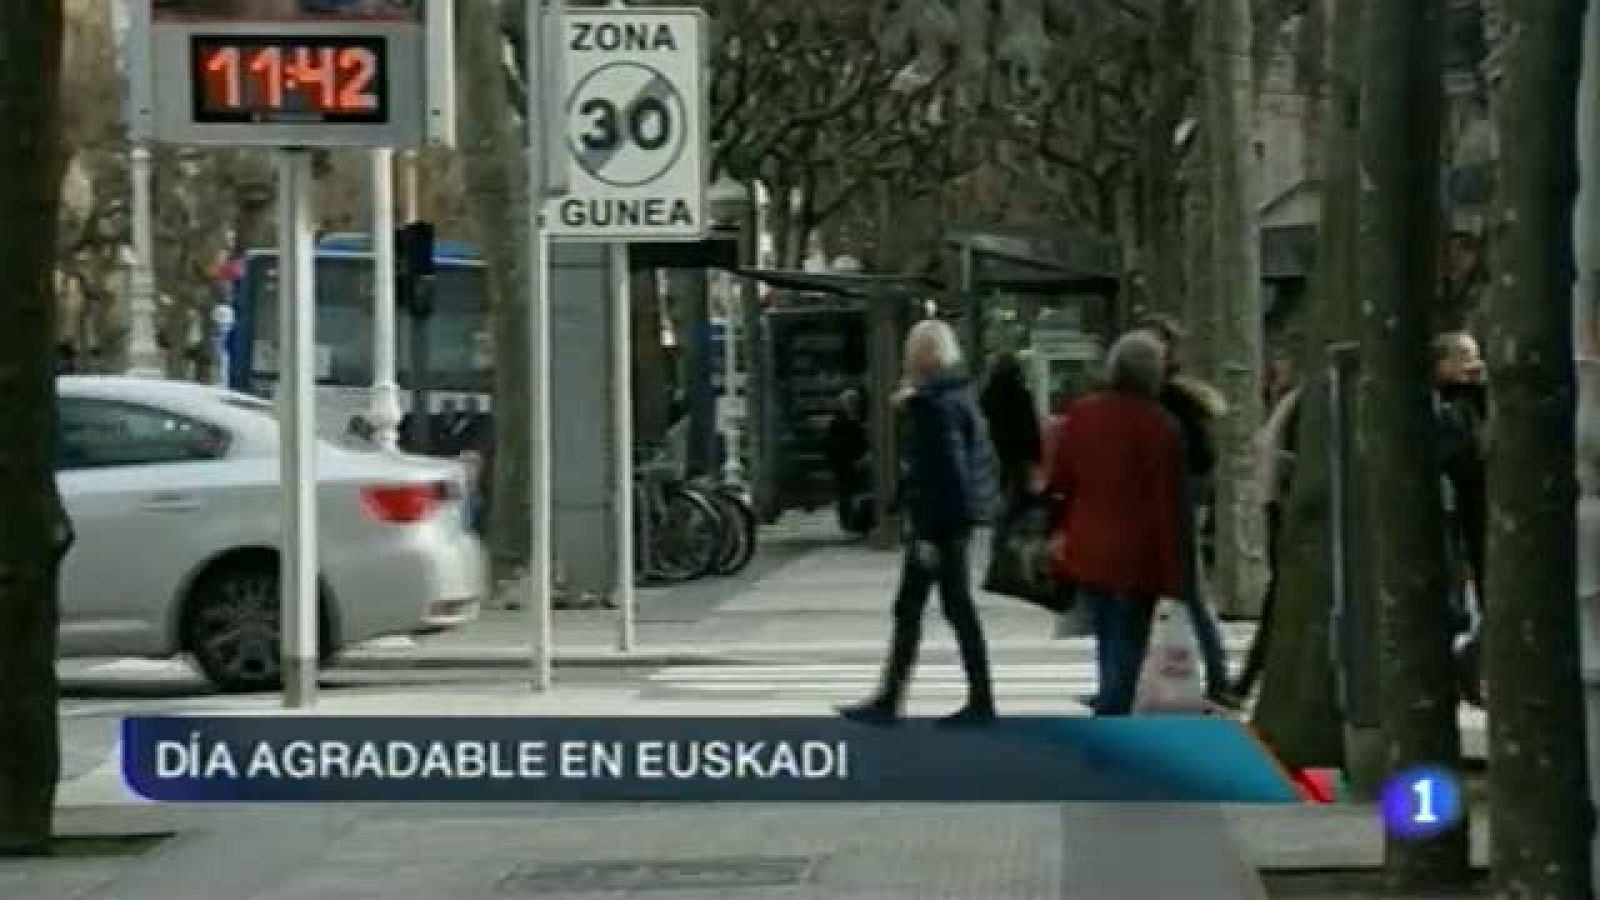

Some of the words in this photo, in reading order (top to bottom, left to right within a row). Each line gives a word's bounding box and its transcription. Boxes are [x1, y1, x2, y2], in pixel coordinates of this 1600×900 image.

[570, 22, 677, 51] ZONA
[579, 97, 671, 151] 30
[560, 199, 693, 227] GUNEA
